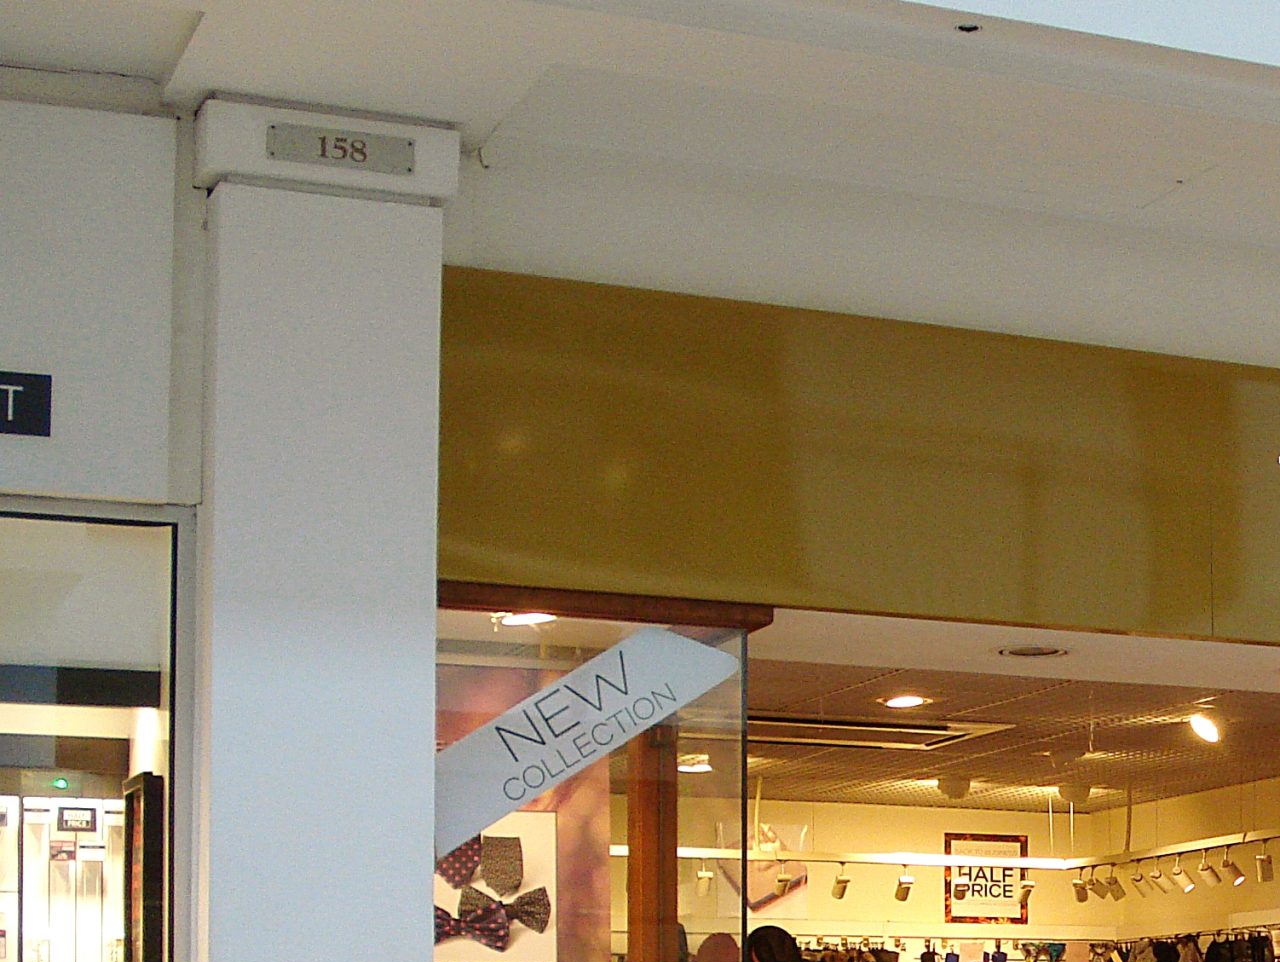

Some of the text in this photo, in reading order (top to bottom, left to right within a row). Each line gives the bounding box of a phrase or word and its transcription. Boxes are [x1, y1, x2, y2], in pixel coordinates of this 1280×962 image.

[317, 135, 368, 163] 158
[494, 650, 629, 763] NEW
[503, 682, 678, 801] COLLECTION
[957, 866, 1014, 883] HALF
